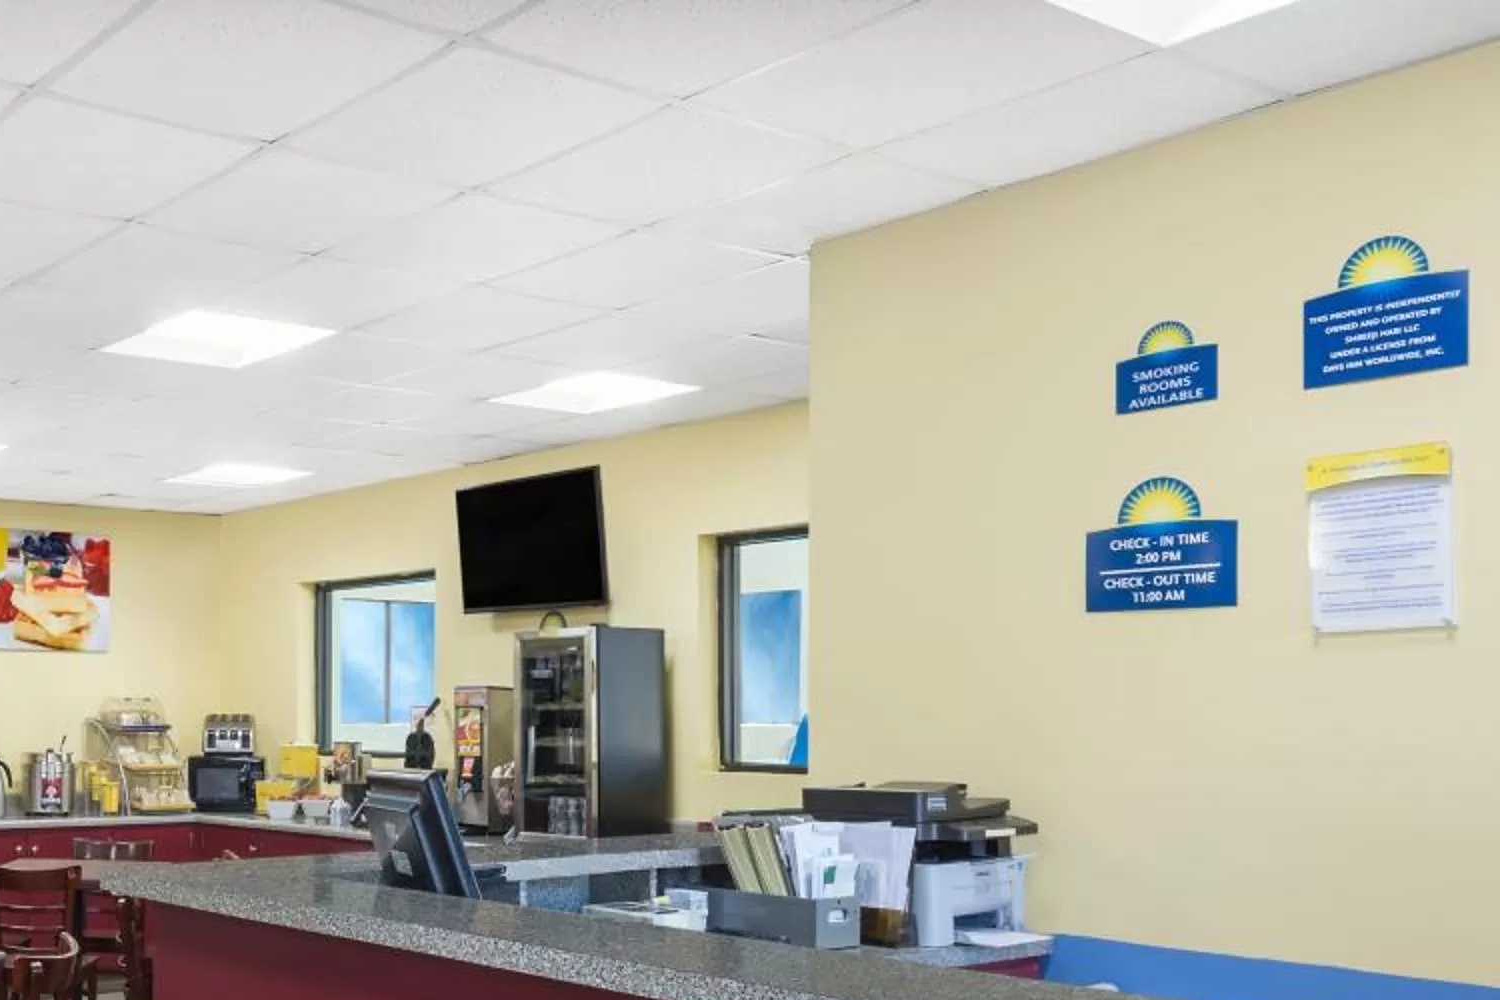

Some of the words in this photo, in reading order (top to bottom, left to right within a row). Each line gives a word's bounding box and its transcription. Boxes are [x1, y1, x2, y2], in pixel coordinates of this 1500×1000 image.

[1329, 306, 1373, 321] PROPERTY
[1385, 290, 1461, 310] INDEPENDENTLY
[1324, 321, 1359, 335] OWNED
[1359, 317, 1380, 328] AND
[1381, 309, 1429, 325] OPERATED
[1429, 306, 1443, 315] BY
[1403, 323, 1421, 332] LLC
[1329, 346, 1361, 359] UNDER
[1361, 344, 1369, 353] A
[1369, 339, 1407, 352] LICENSE
[1408, 334, 1436, 346] FROM
[1131, 361, 1200, 383] SMOKING
[1322, 362, 1344, 373] DAYS
[1139, 375, 1192, 394] ROOMS
[1128, 387, 1204, 410] AVAILABLE
[1109, 537, 1150, 551] CHECK
[1159, 535, 1174, 547] IN
[1177, 531, 1210, 545] TIME
[1135, 552, 1159, 565] 2:00
[1161, 550, 1181, 562] PM
[1103, 576, 1145, 590] CHECK
[1153, 573, 1183, 586] OUT
[1183, 571, 1217, 584] TIME
[1132, 591, 1163, 603] 11:00
[1164, 589, 1185, 601] AM
